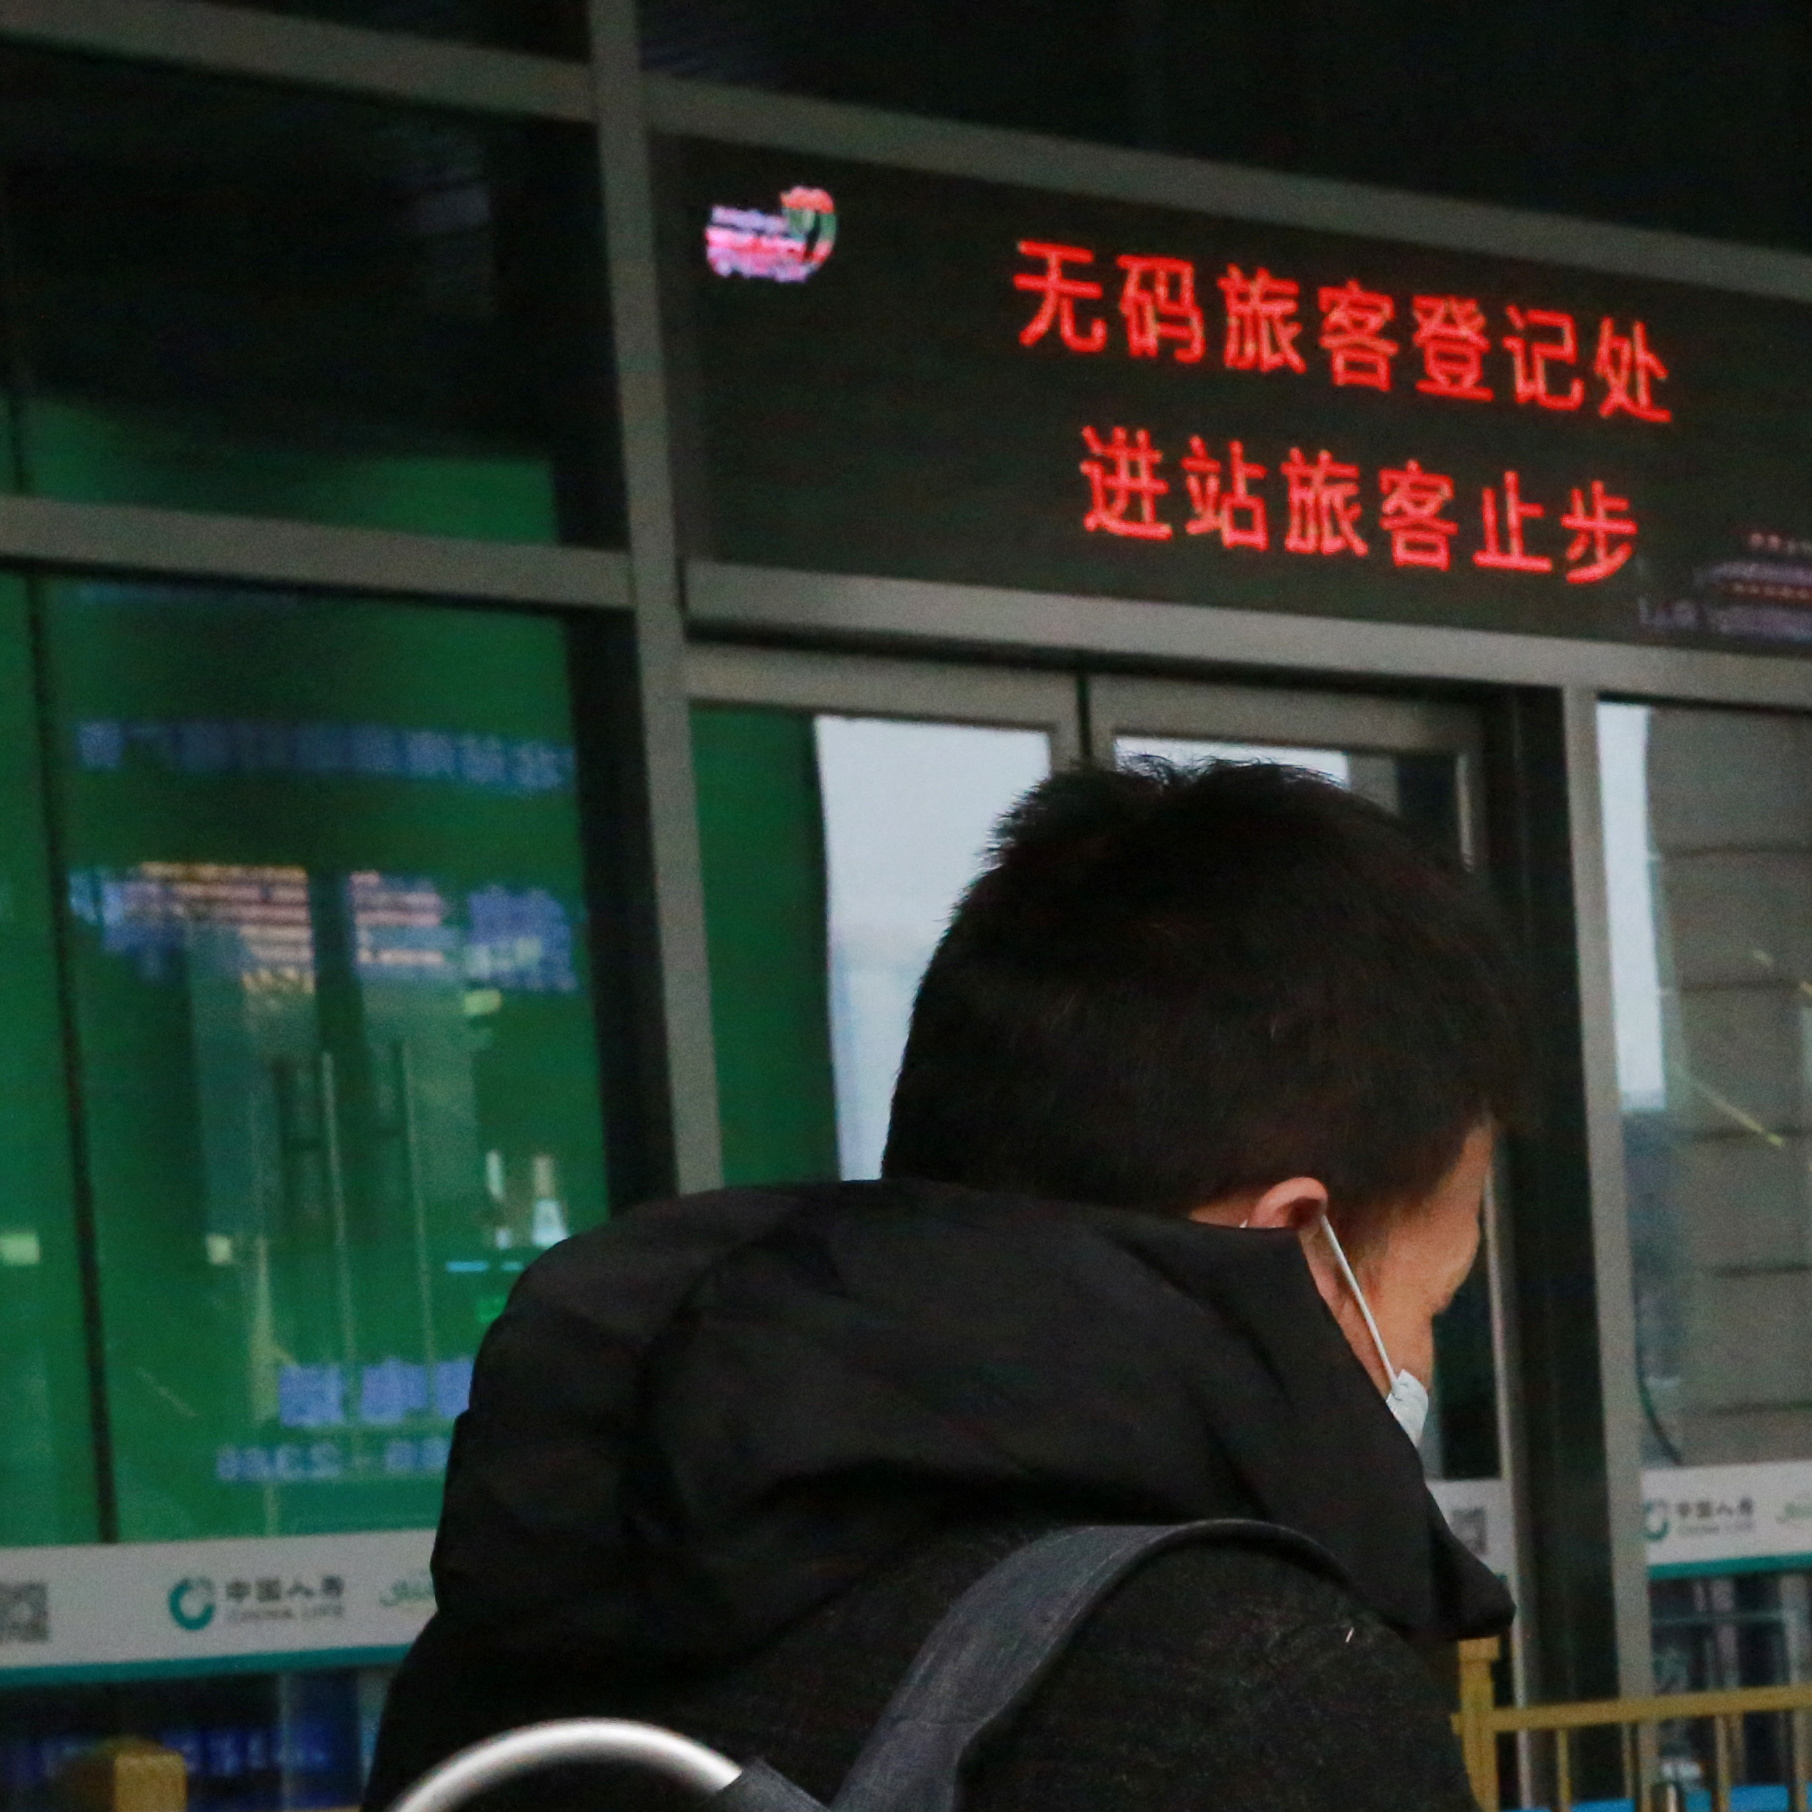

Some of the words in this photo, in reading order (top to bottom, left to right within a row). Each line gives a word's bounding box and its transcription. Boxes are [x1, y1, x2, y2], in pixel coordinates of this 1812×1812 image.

[1013, 239, 1672, 422] 无码旅客登记处
[1079, 426, 1638, 582] 进站旅客止步
